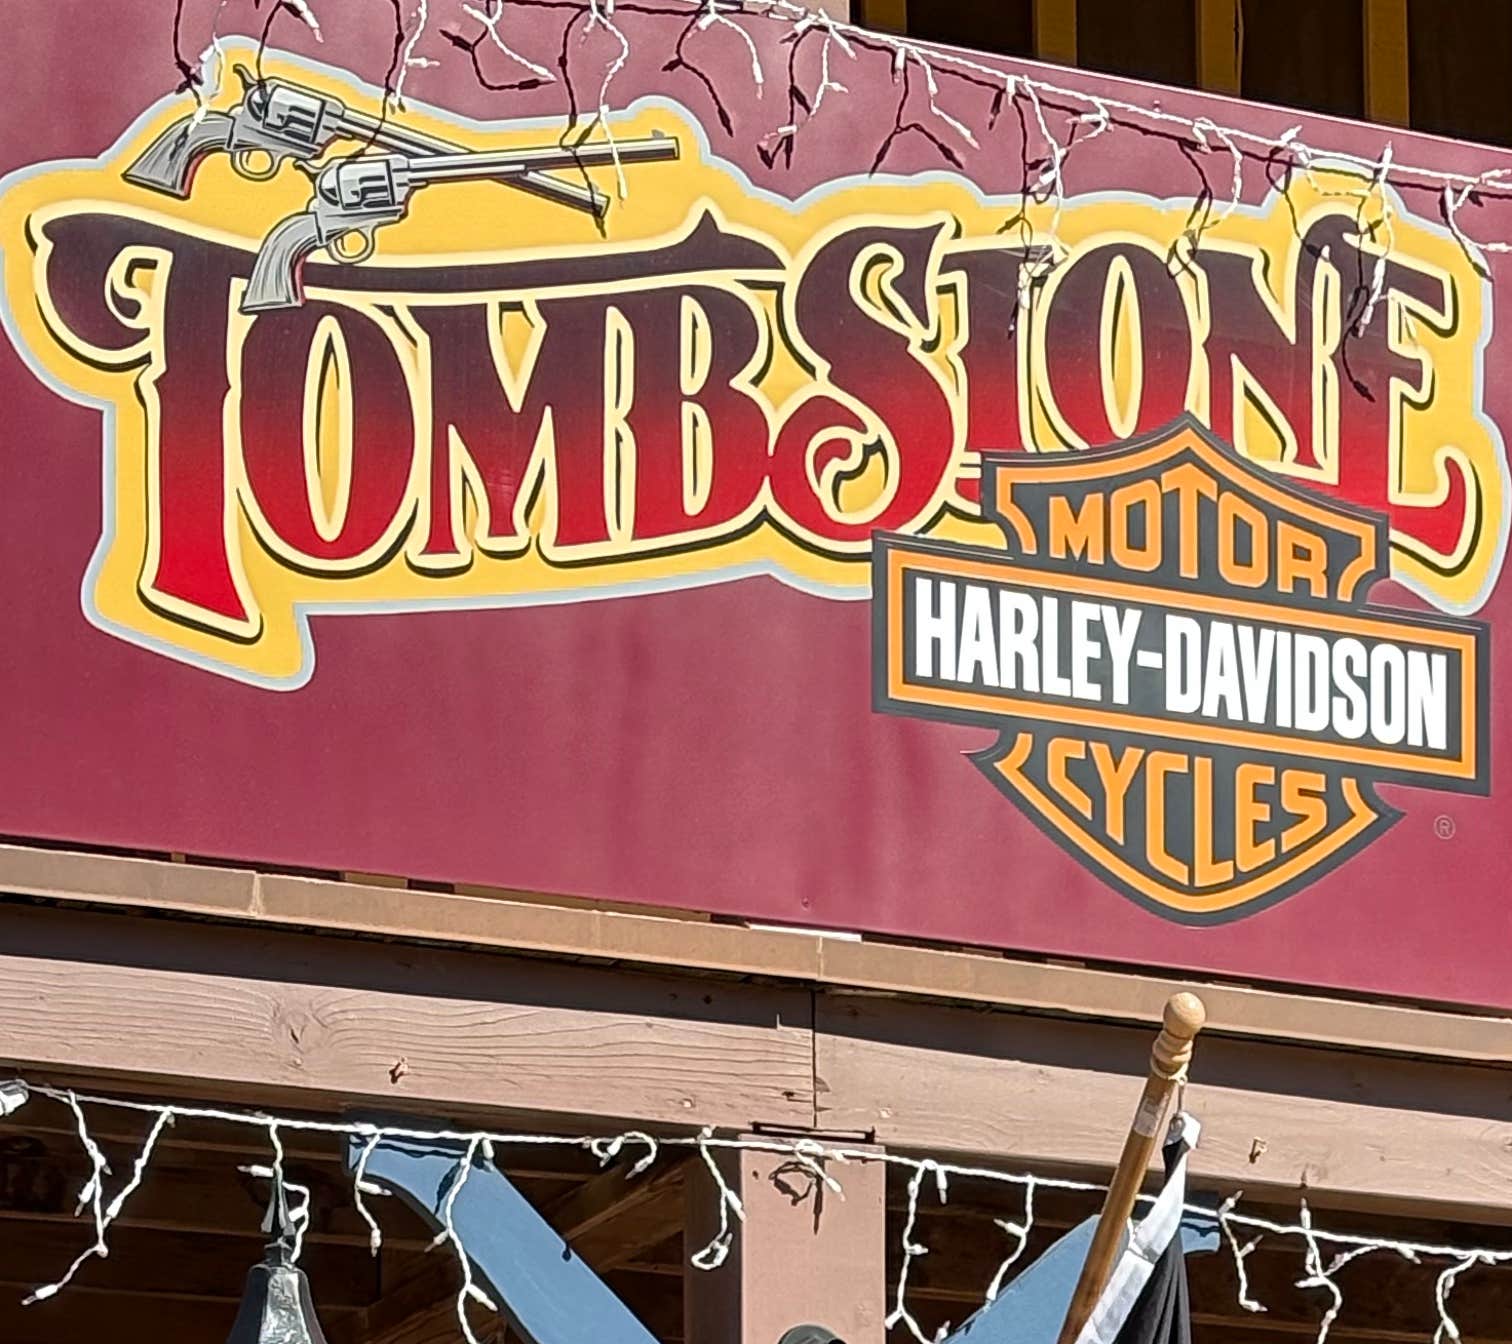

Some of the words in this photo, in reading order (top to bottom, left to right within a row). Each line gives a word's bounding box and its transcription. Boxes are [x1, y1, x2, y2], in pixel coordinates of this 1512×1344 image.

[28, 200, 1478, 640] TOMBSTONE
[1049, 464, 1330, 599] MOTOR
[915, 577, 1446, 749] HARLEY-DAVIDSON
[1047, 737, 1329, 888] CYCLES
